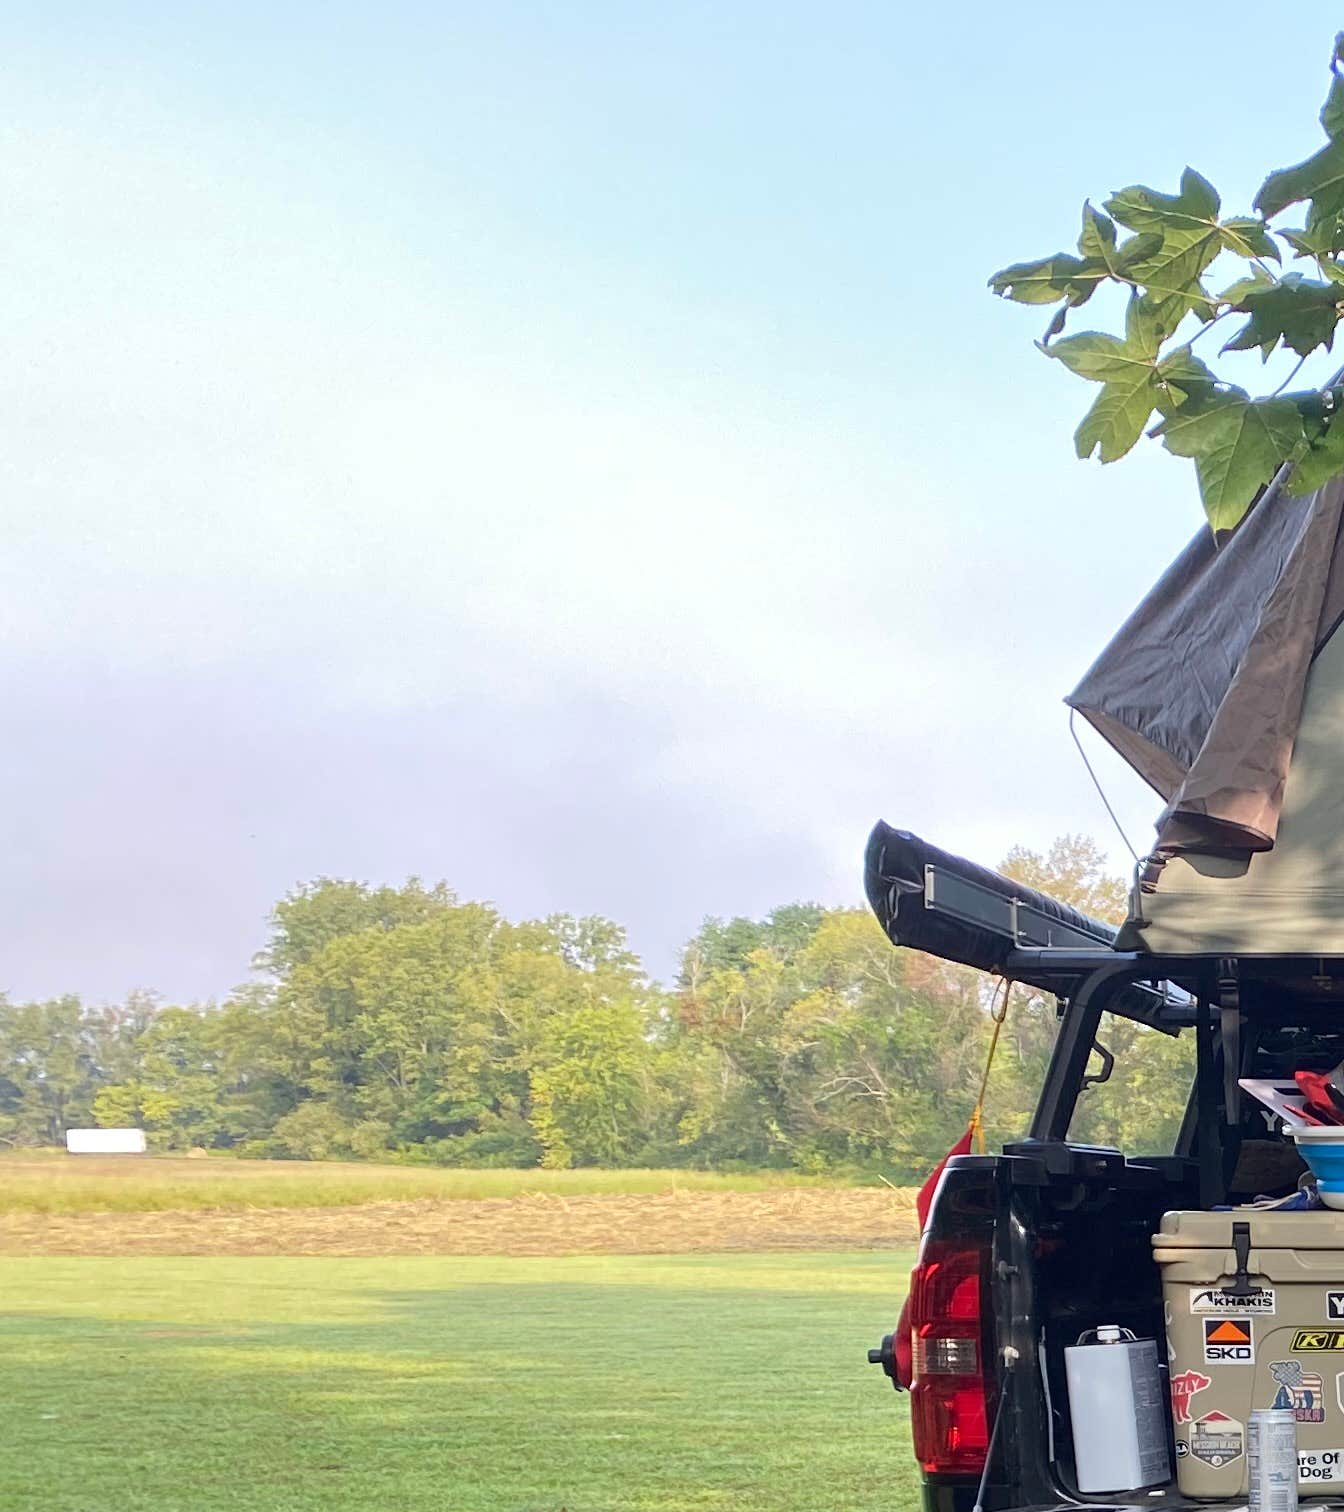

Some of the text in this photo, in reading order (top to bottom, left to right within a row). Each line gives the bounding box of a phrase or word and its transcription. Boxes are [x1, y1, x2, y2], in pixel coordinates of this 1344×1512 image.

[1214, 1297, 1273, 1307] KHAKIS
[1322, 1452, 1340, 1464] Of
[1300, 1466, 1333, 1480] Dog
